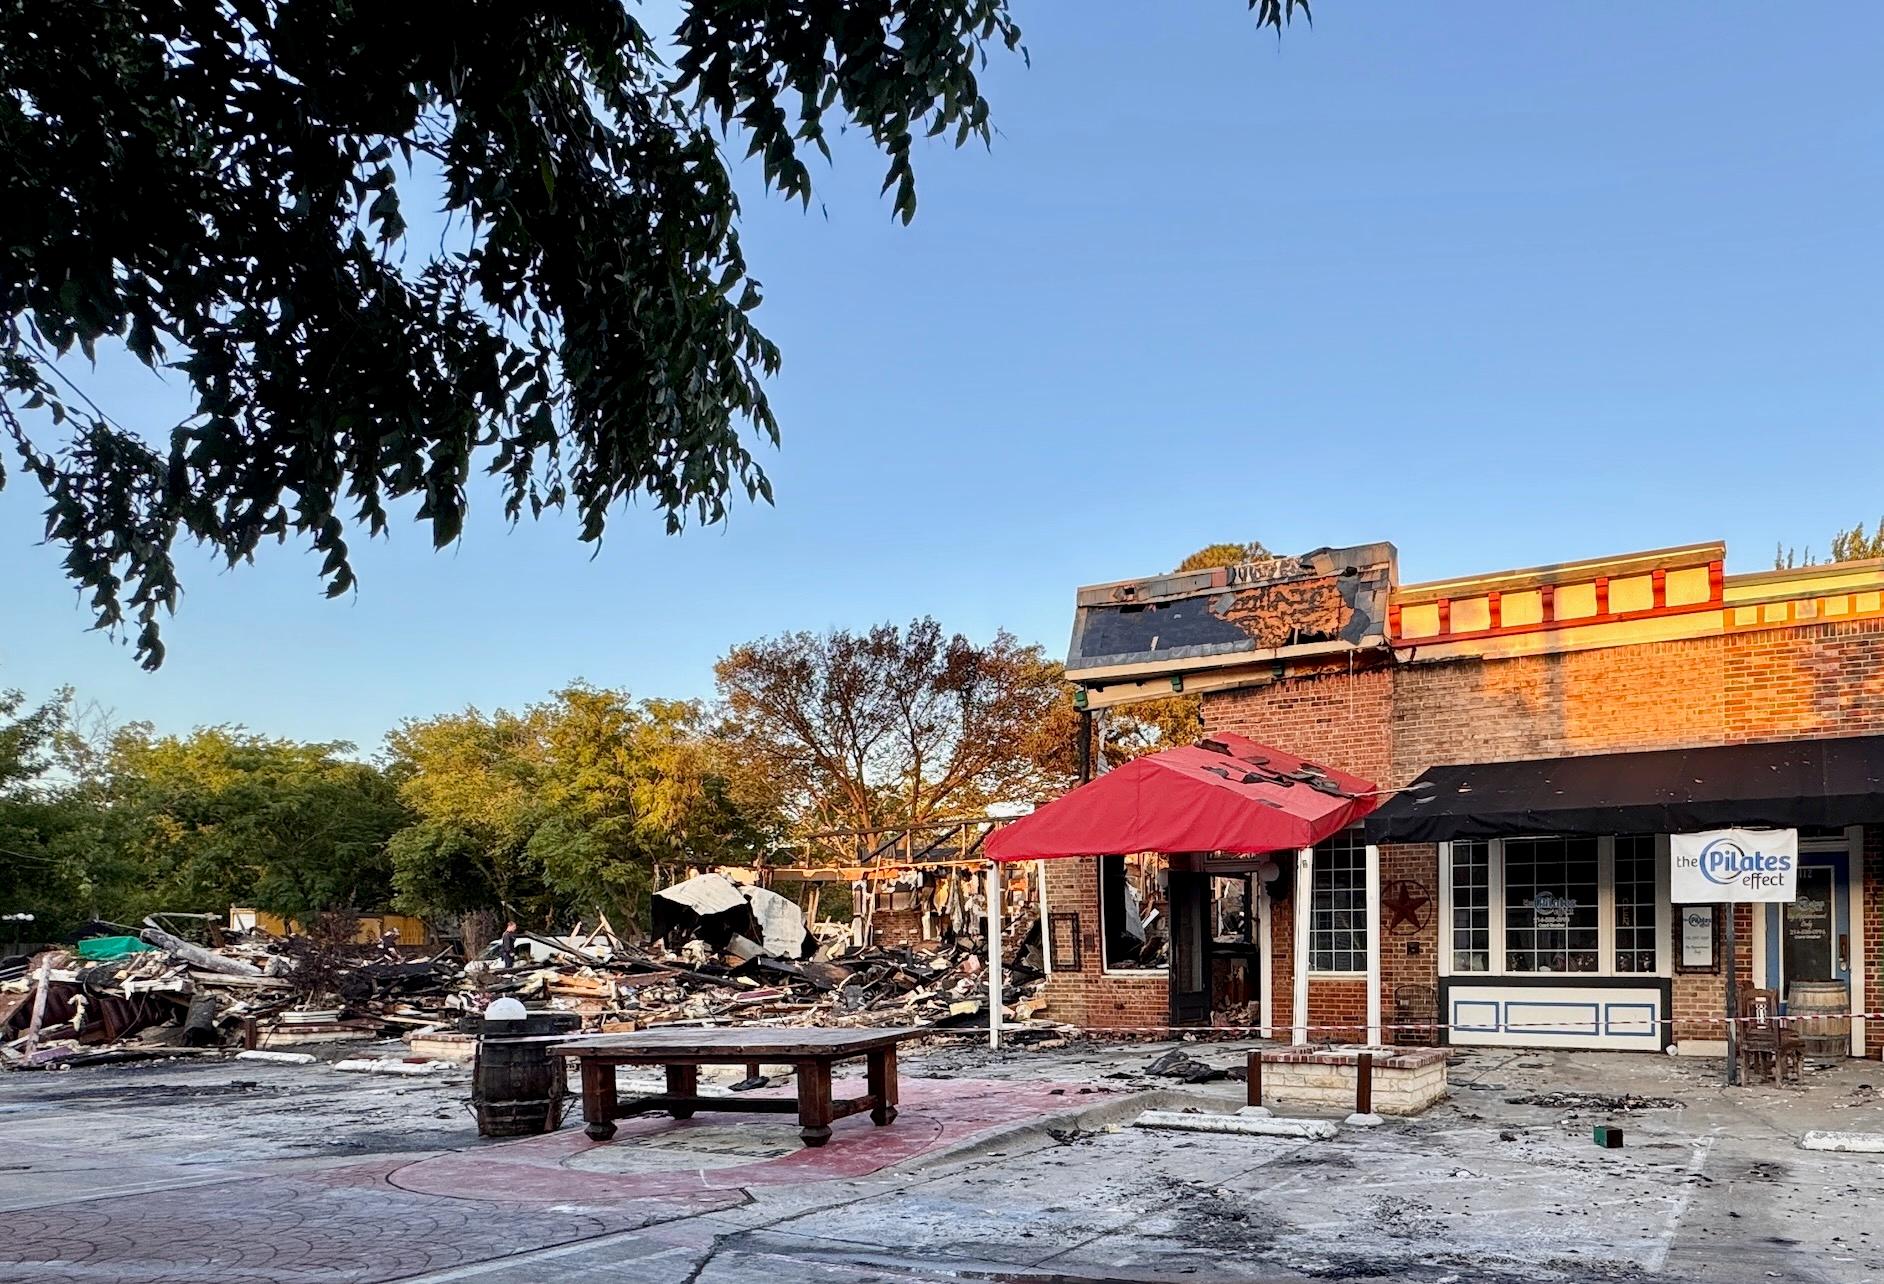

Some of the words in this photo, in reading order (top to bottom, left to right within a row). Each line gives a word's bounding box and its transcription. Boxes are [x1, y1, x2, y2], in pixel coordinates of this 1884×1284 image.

[1676, 856, 1698, 868] the
[1710, 851, 1791, 872] Pilates
[1742, 872, 1785, 889] effect
